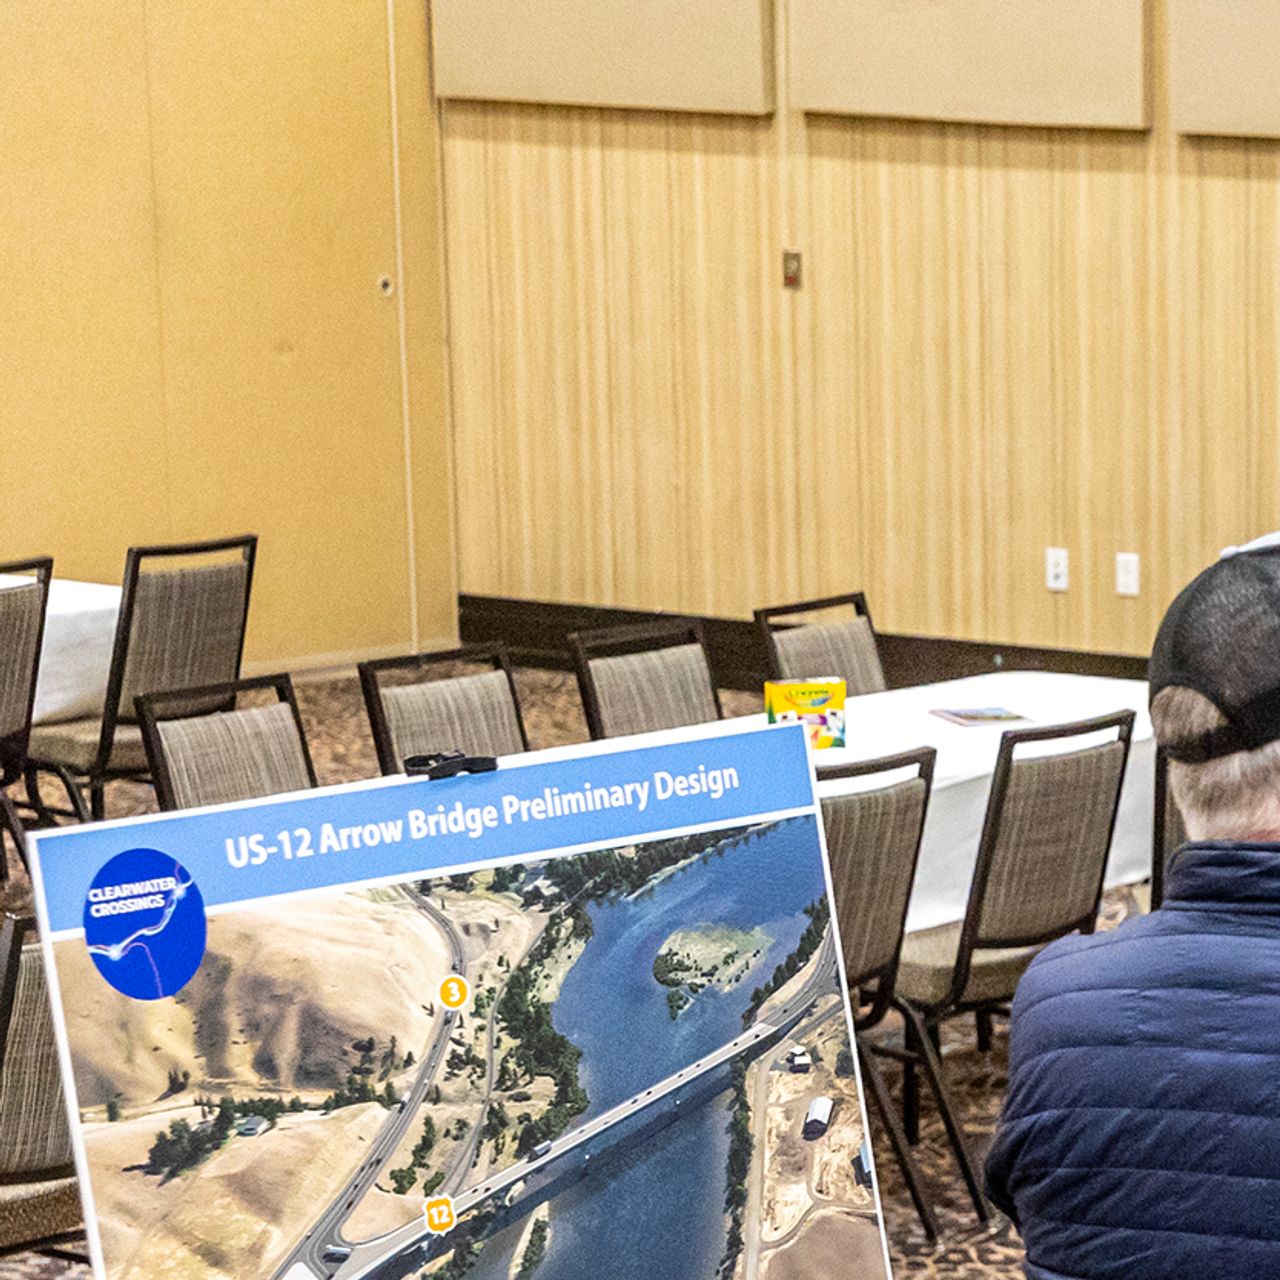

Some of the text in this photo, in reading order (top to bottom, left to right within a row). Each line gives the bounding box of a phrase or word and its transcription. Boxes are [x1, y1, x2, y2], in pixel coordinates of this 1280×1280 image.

[225, 764, 740, 869] US-12 Arrow Bridge Preliminary Design
[88, 876, 177, 903] CLEARWATER
[90, 894, 165, 918] CROSSINGS
[448, 982, 460, 1001] 3
[430, 1205, 451, 1226] 12
